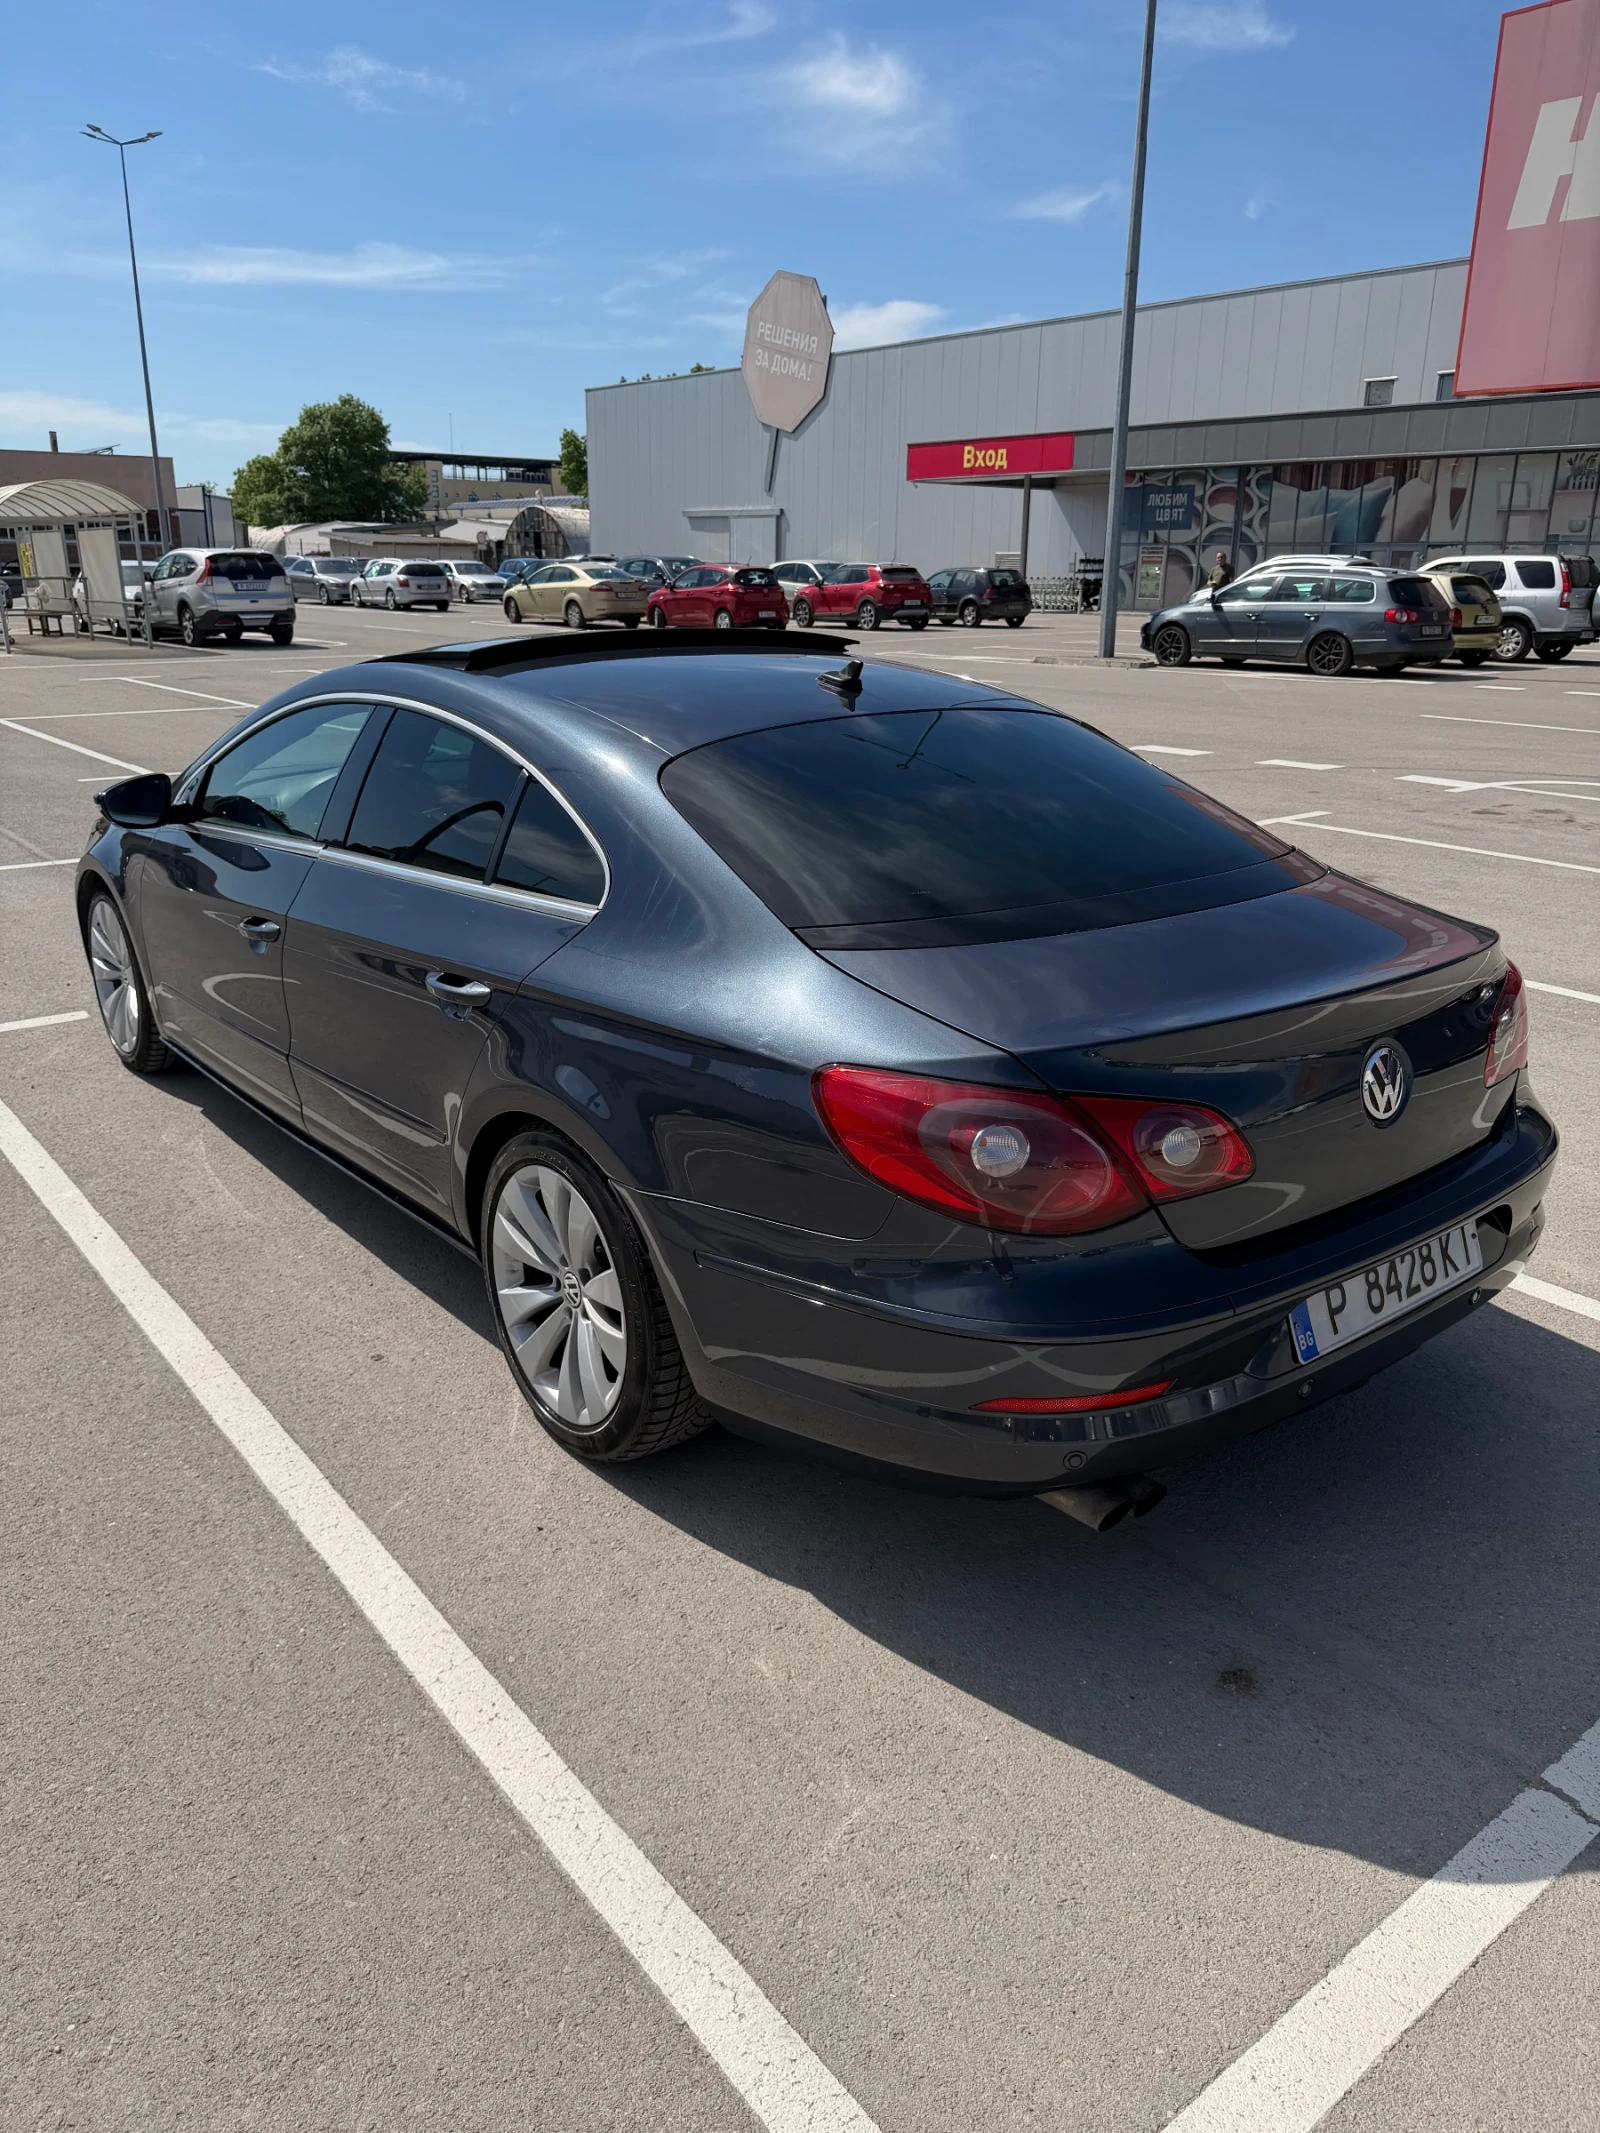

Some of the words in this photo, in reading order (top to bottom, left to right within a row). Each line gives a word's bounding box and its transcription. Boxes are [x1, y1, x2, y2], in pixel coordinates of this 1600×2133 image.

[757, 321, 818, 354] РЕШЕНИЯ
[755, 349, 769, 369] ЗА
[771, 354, 812, 381] ДОМА!
[963, 445, 1008, 470] Вход
[1147, 492, 1188, 506] ЛЮБИМ
[1155, 508, 1185, 523] ЦВЯТ
[1299, 1331, 1315, 1351] BG
